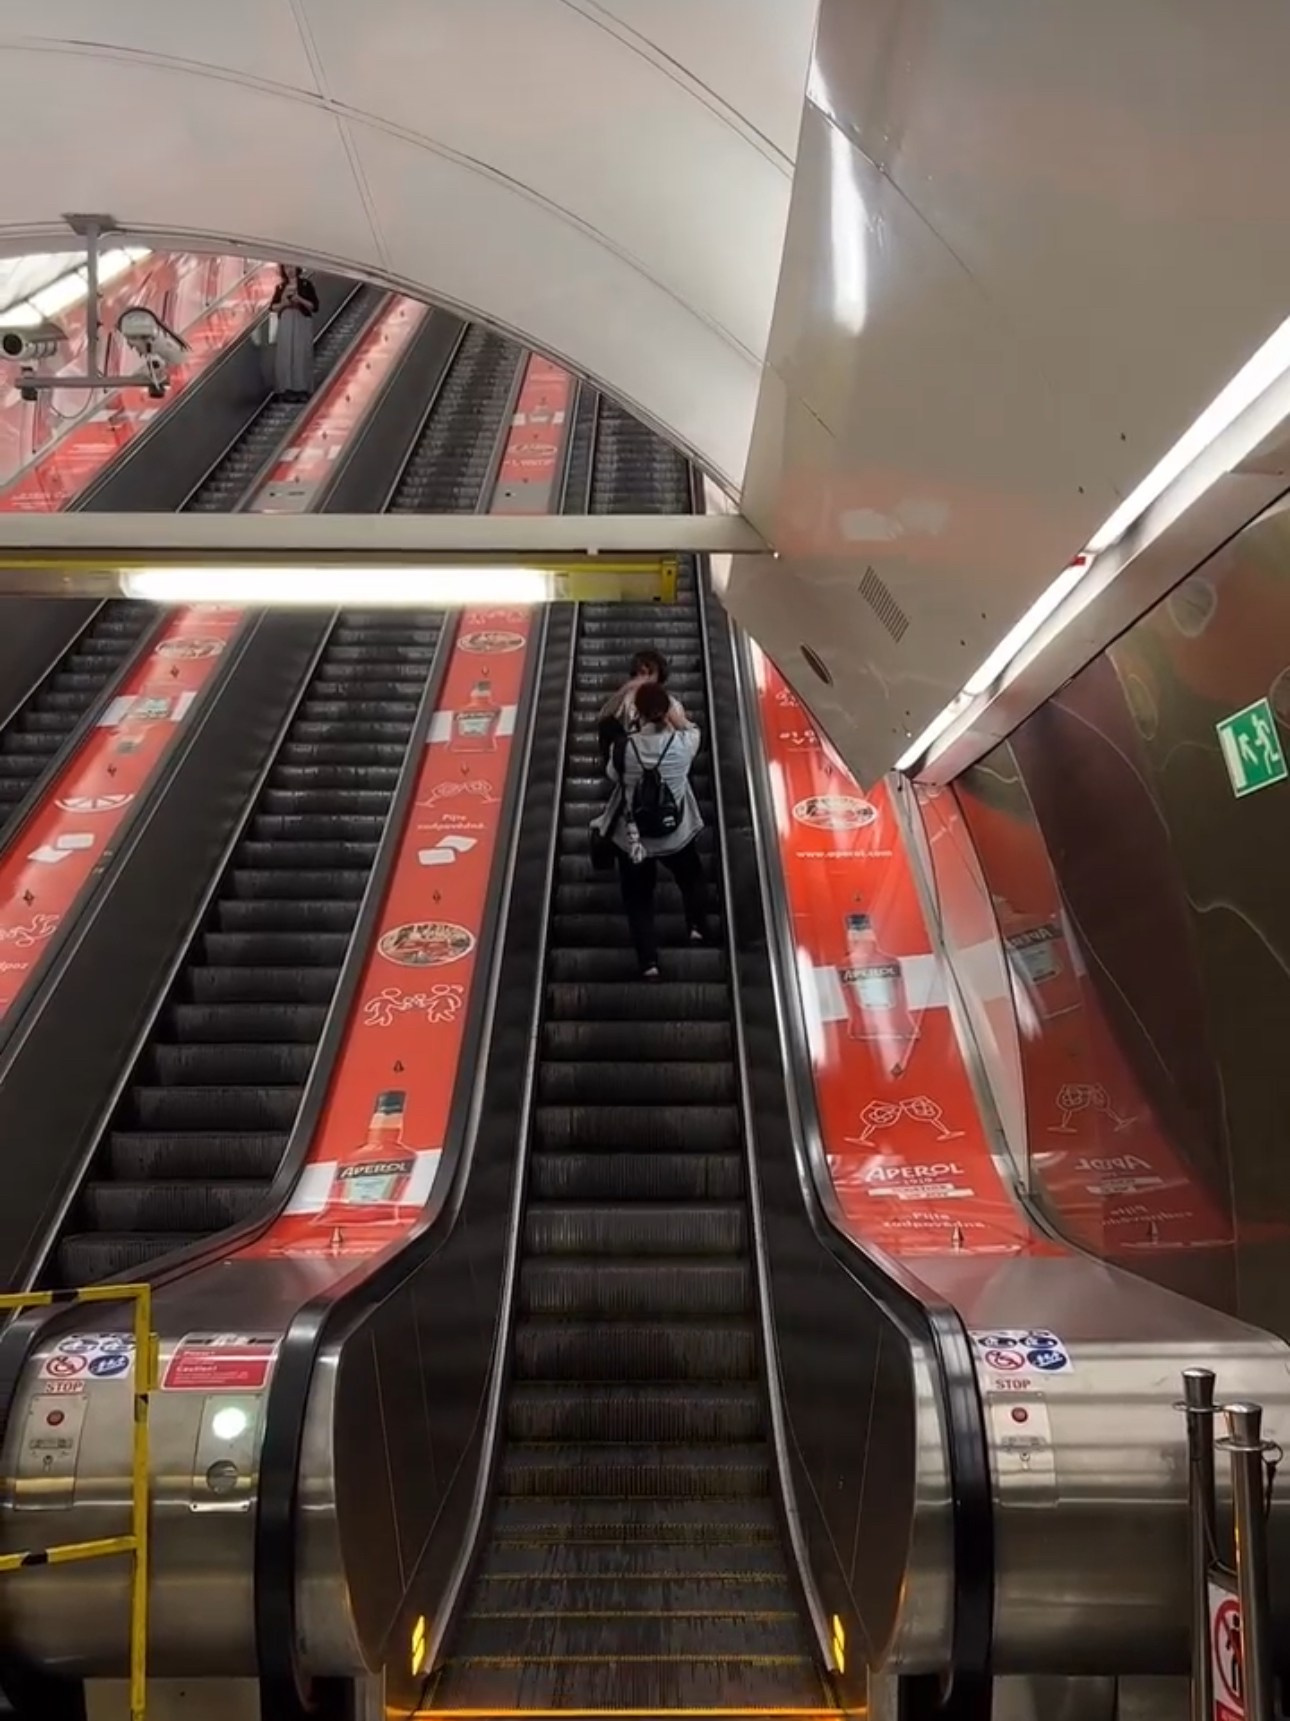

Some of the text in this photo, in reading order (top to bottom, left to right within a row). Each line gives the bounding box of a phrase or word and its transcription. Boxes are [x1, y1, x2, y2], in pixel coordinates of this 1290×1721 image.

[341, 1162, 407, 1178] APEROL
[864, 1162, 965, 1182] APEROL
[46, 1380, 83, 1393] STOP
[996, 1378, 1031, 1390] STOP
